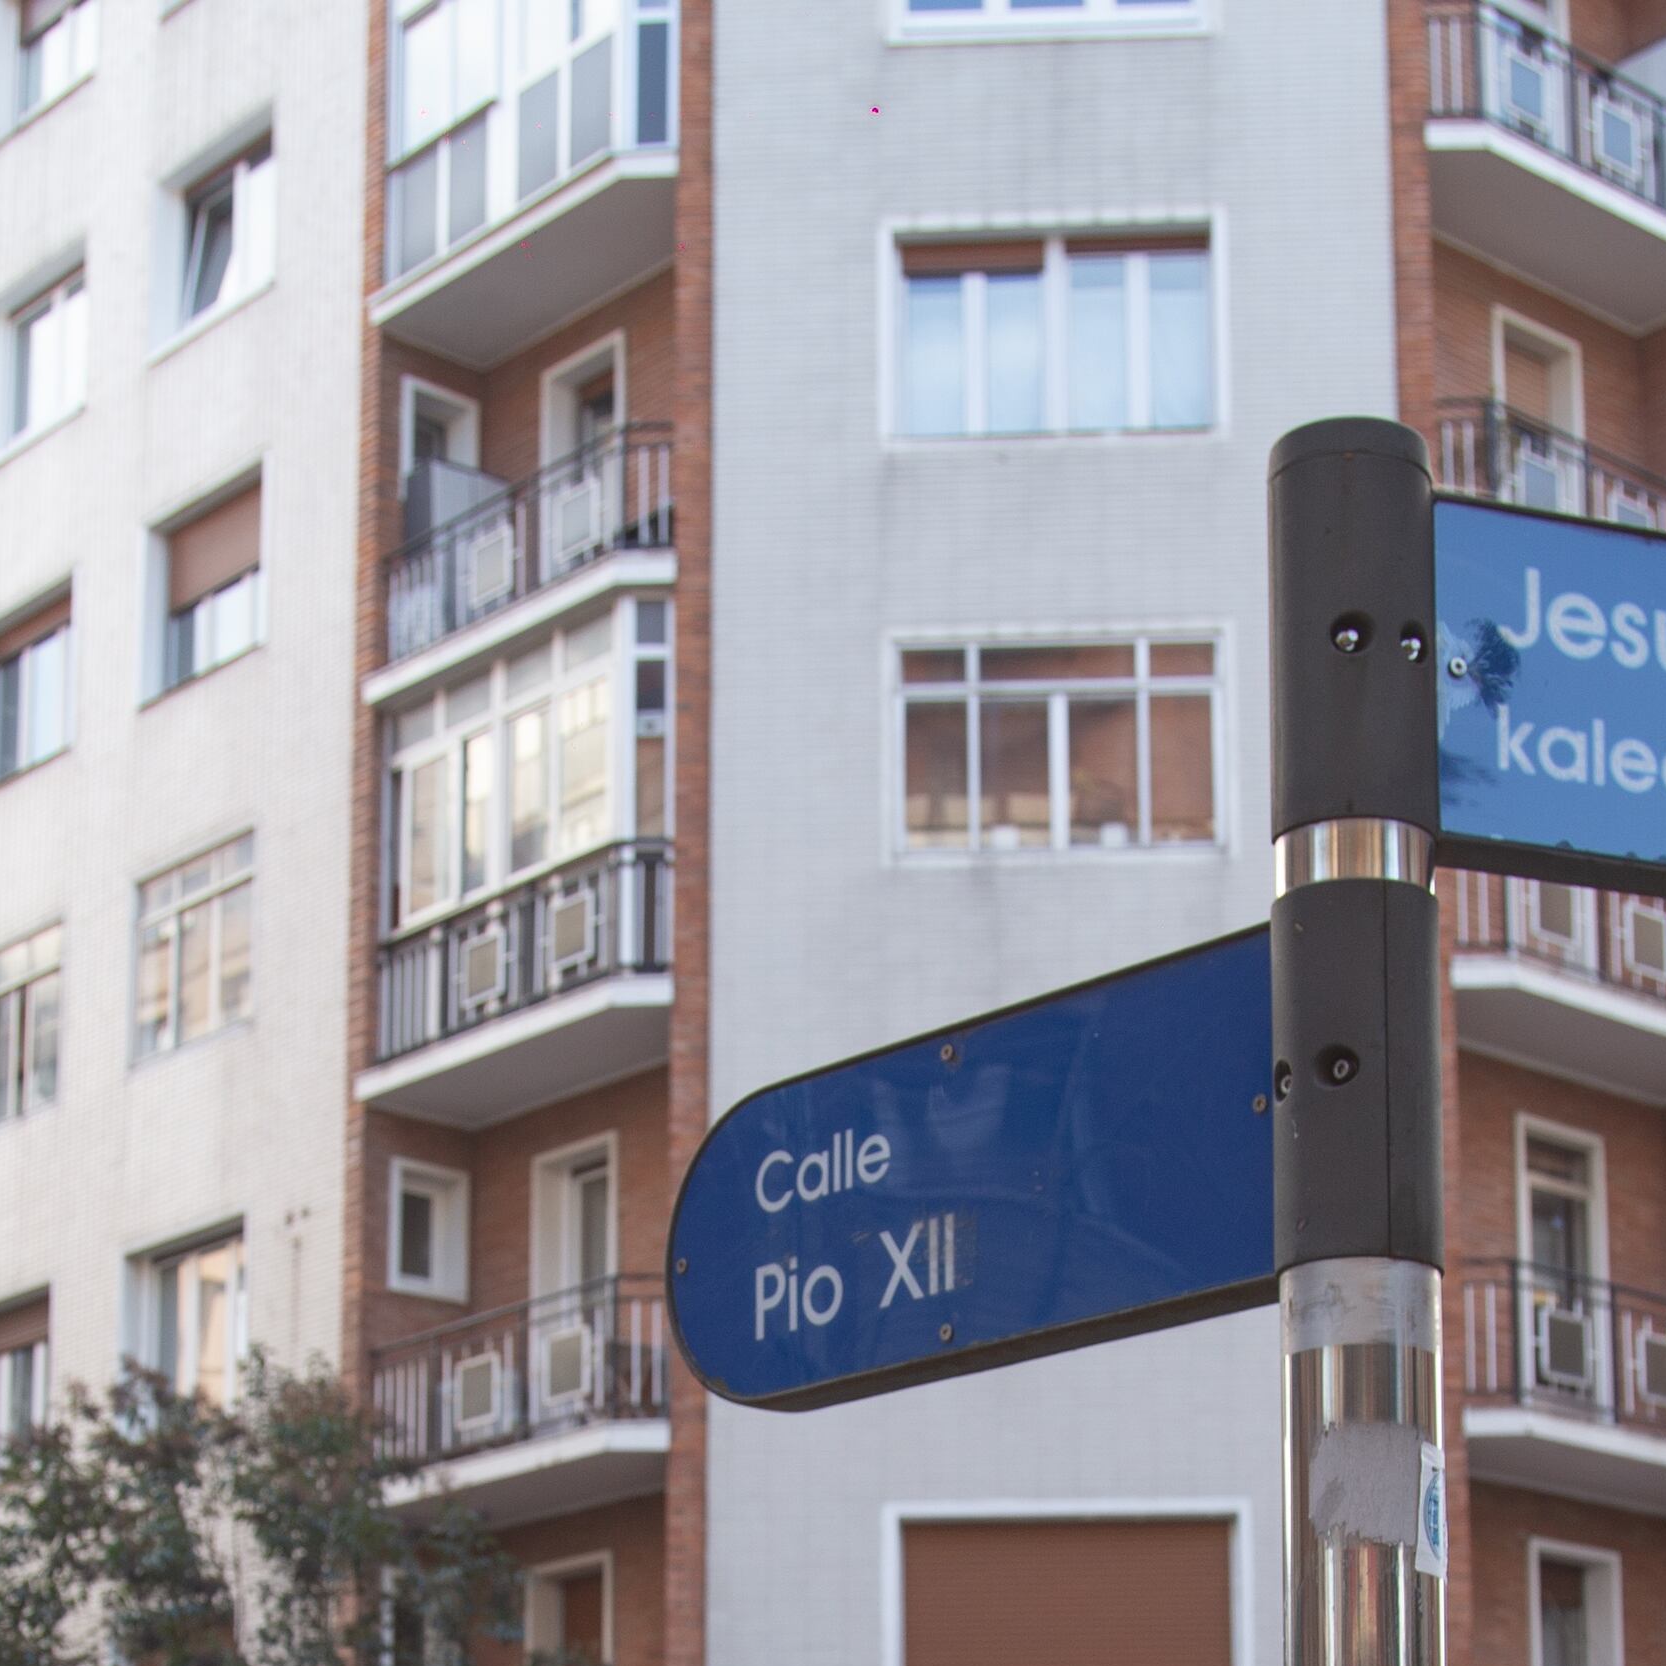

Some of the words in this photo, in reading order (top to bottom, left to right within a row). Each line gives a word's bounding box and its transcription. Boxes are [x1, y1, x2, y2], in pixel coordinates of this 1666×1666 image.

[755, 1128, 891, 1213] Calle
[755, 1256, 843, 1341] Pio
[879, 1213, 955, 1309] XII
